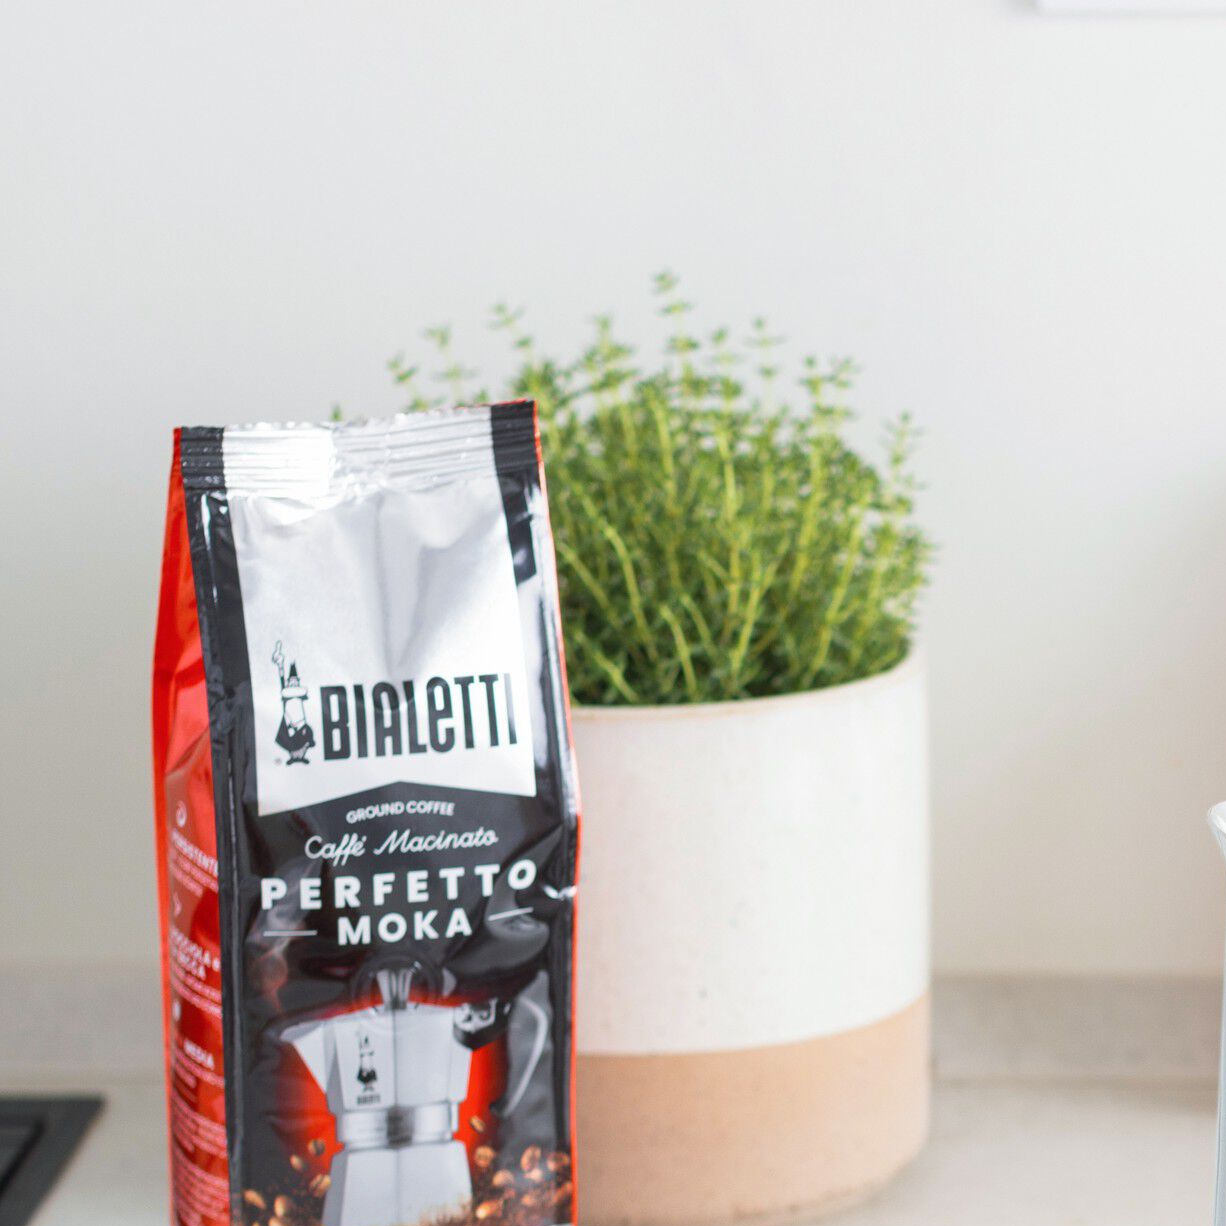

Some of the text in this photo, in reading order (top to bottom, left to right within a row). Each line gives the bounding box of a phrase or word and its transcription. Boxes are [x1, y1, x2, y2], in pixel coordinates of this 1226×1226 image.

[345, 800, 456, 824] GROUND COFFEE
[373, 826, 499, 856] Macinato
[260, 858, 537, 911] PERFETTO
[337, 907, 473, 946] MOKA
